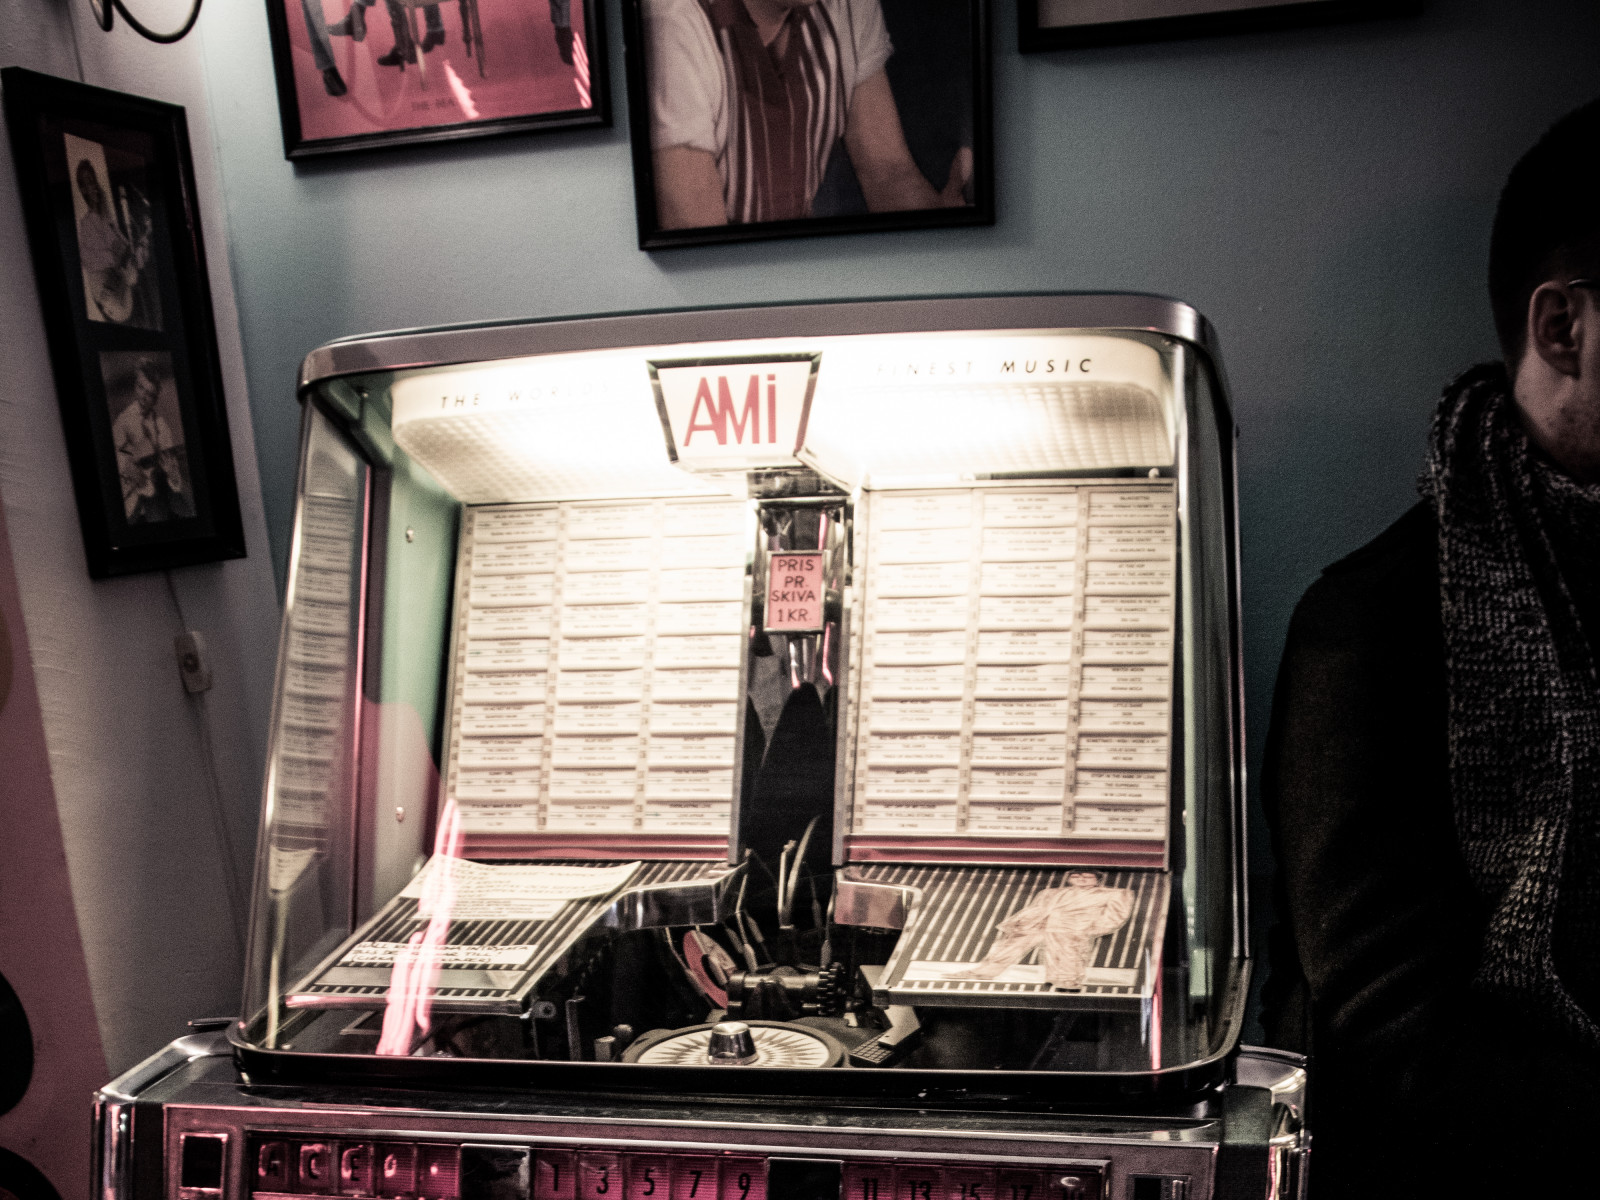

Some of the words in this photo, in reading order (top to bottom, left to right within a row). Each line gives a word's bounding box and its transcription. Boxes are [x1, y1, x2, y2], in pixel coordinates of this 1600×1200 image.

[1000, 358, 1093, 374] MUSIC
[440, 392, 481, 409] THE
[778, 559, 814, 571] PRIS
[784, 576, 809, 588] PR.
[771, 590, 816, 602] SKIVA
[266, 1149, 279, 1177] A
[308, 1152, 319, 1180] C
[351, 1153, 360, 1182] E
[551, 1164, 559, 1191] 1
[596, 1166, 609, 1194] 3
[643, 1167, 655, 1196] 5
[690, 1170, 702, 1198] 7
[738, 1173, 751, 1200] 9
